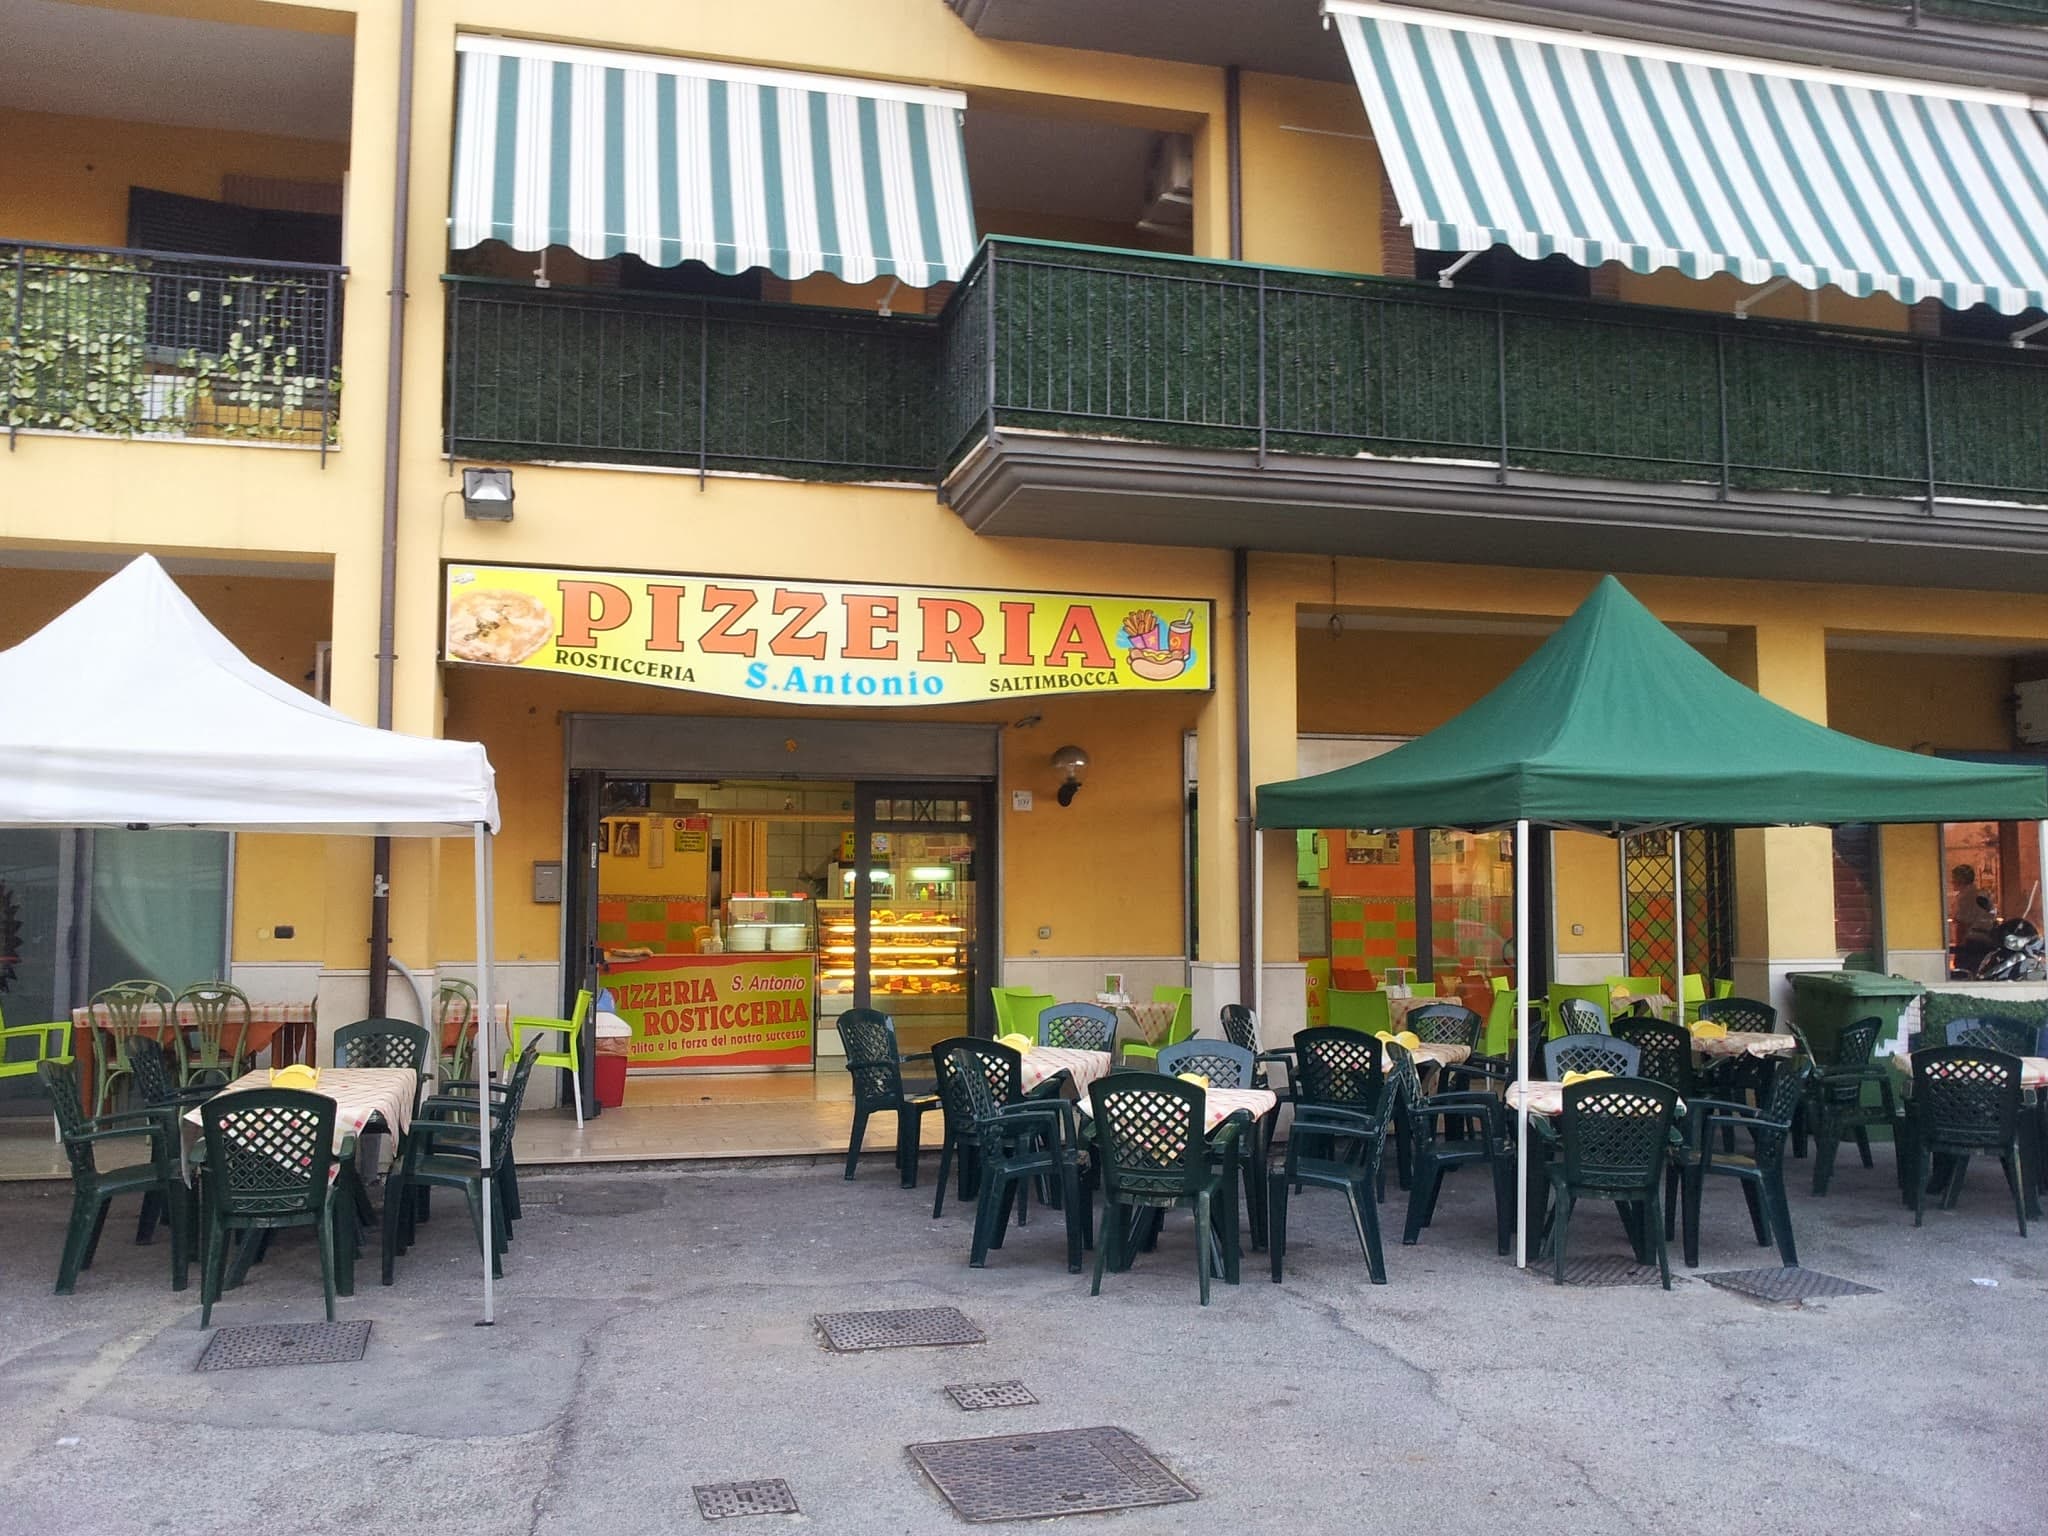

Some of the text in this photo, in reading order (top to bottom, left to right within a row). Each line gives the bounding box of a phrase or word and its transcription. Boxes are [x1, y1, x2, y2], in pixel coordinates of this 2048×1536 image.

[555, 579, 1117, 669] PIZZERIA
[555, 649, 696, 683] ROSTICCERIA
[989, 671, 1120, 693] SALTIMBOCCA
[731, 974, 805, 991] S. Antonio
[643, 998, 809, 1036] ROSTICCERIA
[658, 1043, 665, 1052] e
[668, 1040, 678, 1050] la
[711, 1034, 726, 1046] del
[730, 1033, 762, 1045] nostro
[766, 1030, 806, 1042] successo
